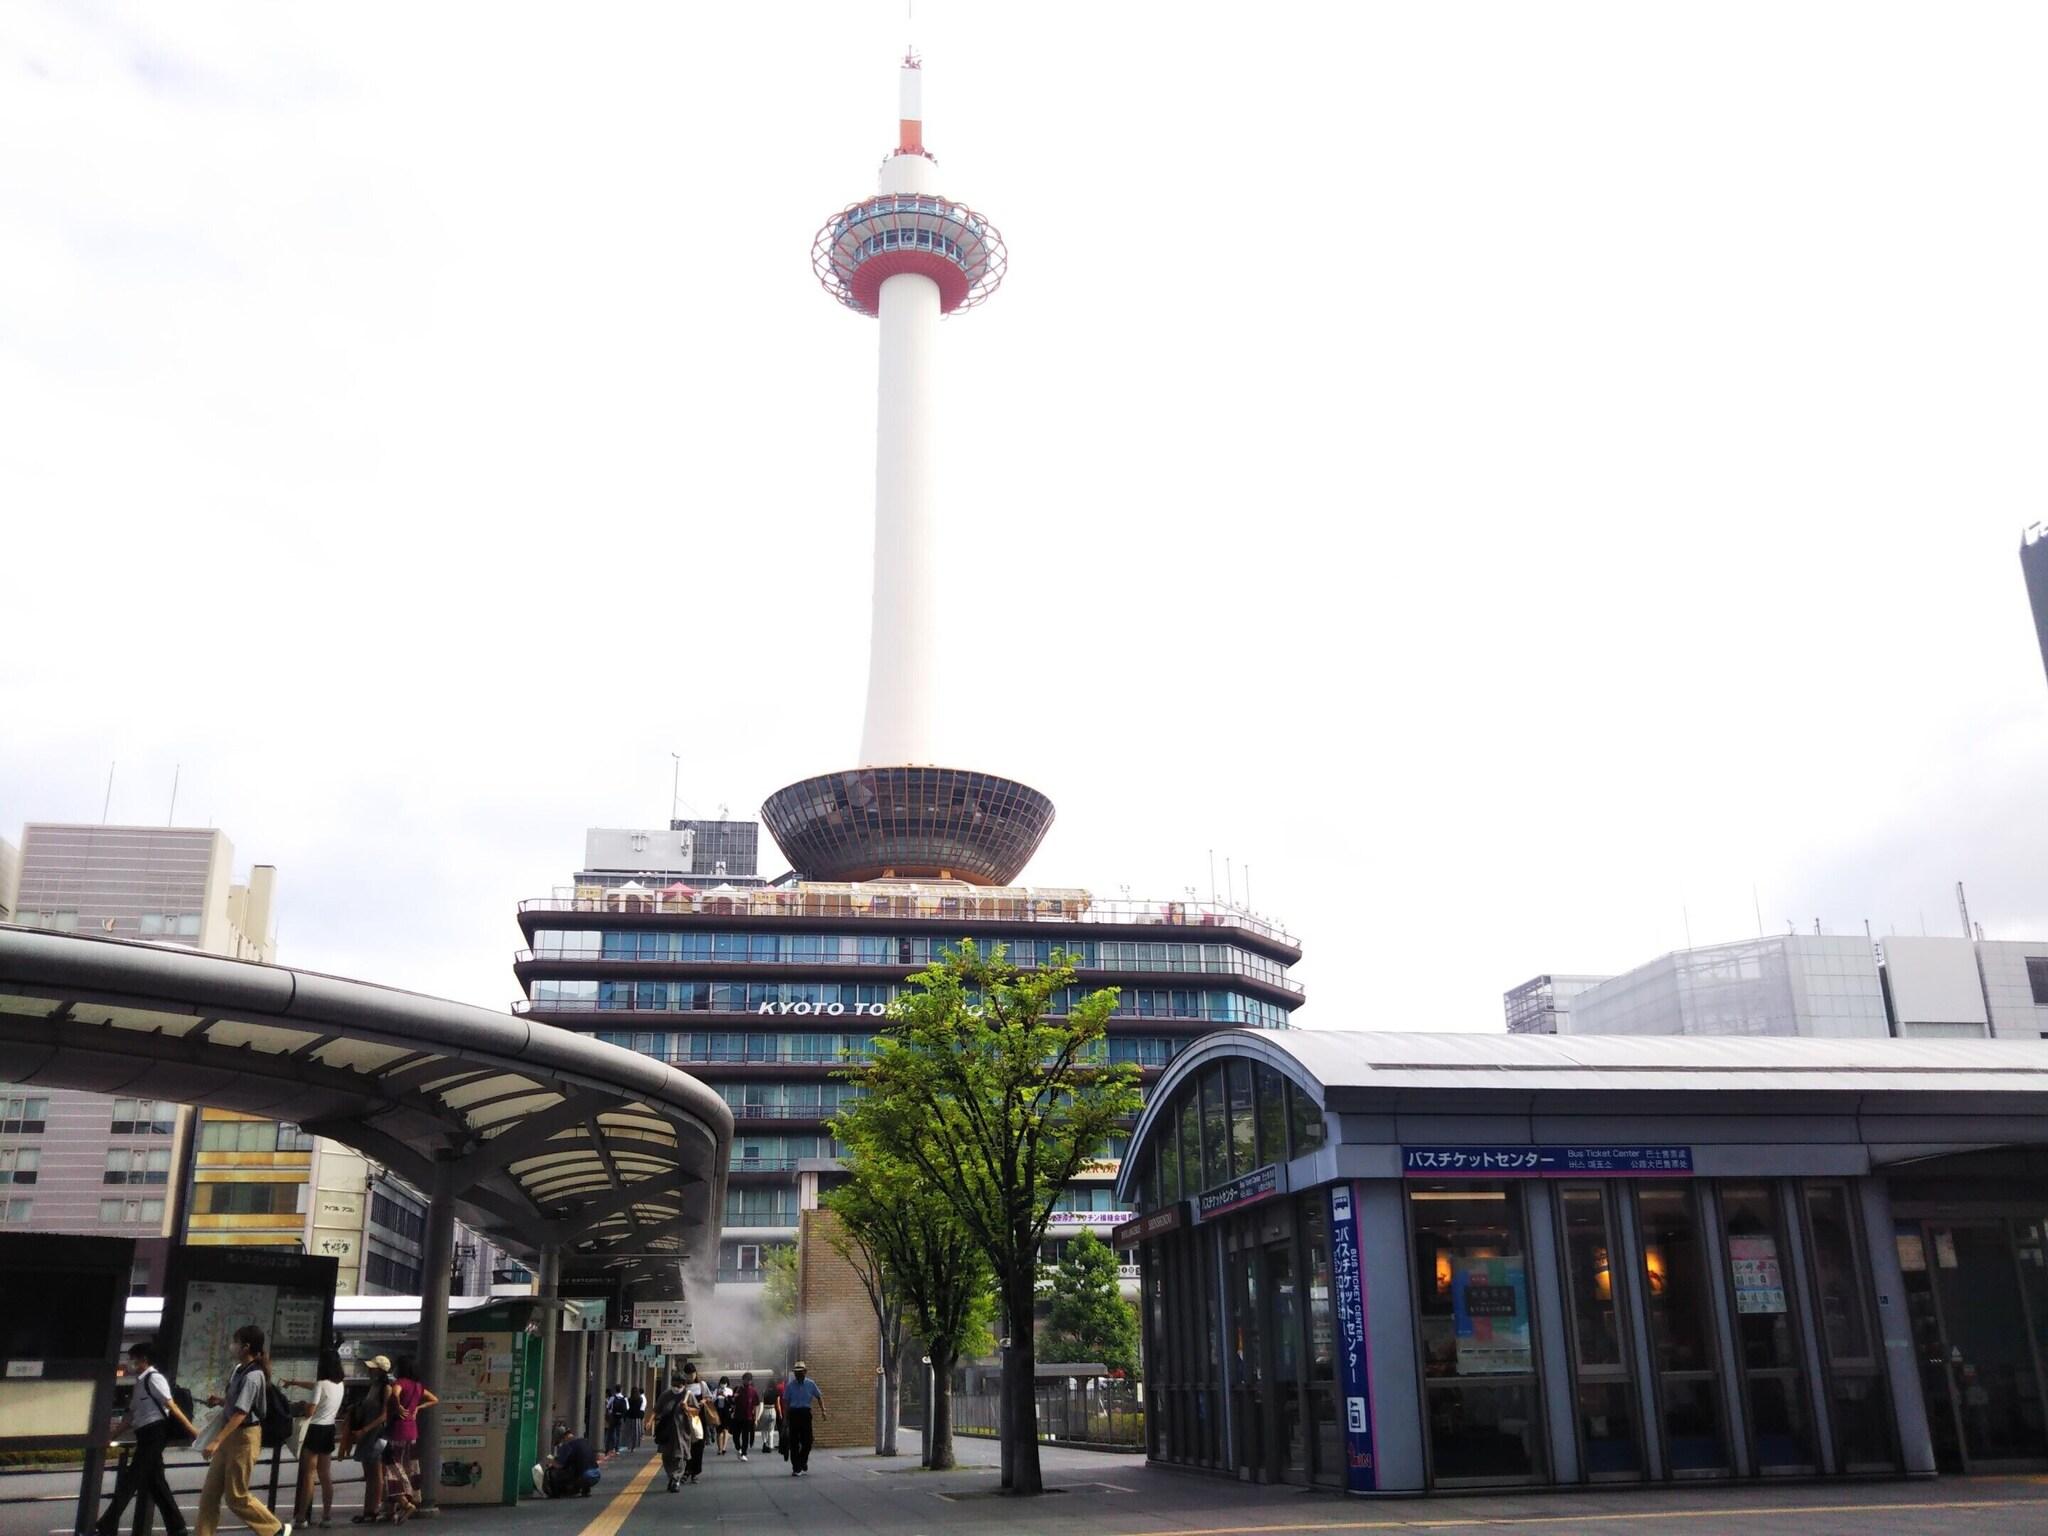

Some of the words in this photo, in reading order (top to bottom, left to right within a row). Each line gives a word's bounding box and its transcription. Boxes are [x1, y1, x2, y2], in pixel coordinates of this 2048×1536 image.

[758, 1001, 845, 1016] KYOTO
[1408, 1152, 1555, 1168] バスチケットセンター
[1567, 1149, 1584, 1158] Bus
[1586, 1149, 1610, 1158] Ticket
[1612, 1149, 1640, 1158] Center
[1201, 1187, 1238, 1210] バスチケットセンター
[1349, 1248, 1358, 1267] BUS
[1351, 1269, 1361, 1302] TICKET
[1340, 1226, 1358, 1384] バスチケットセンター
[1354, 1304, 1363, 1343] CENTER
